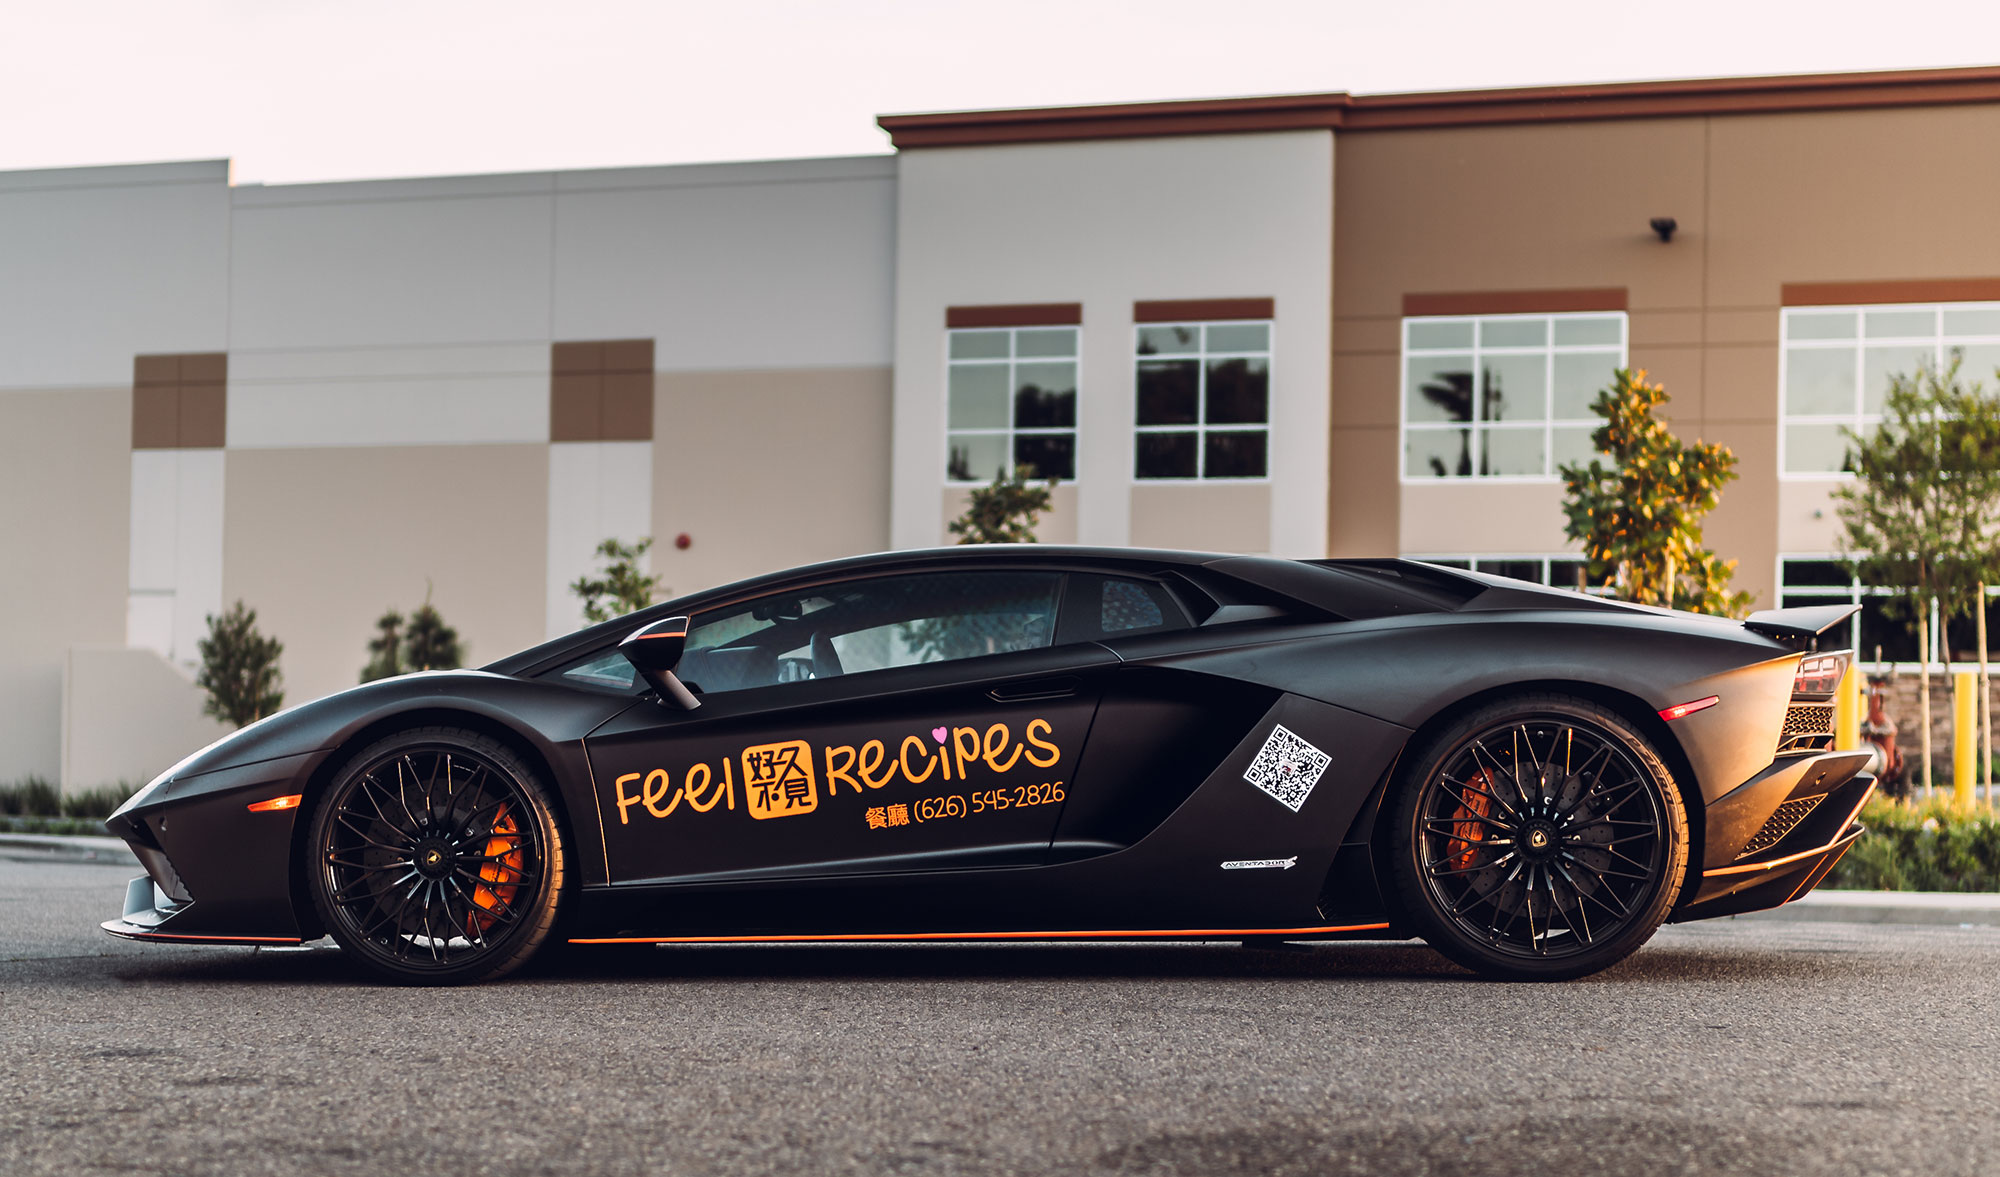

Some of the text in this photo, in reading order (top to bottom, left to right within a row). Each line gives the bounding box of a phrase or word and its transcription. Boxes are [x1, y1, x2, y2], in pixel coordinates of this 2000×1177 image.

[616, 719, 1061, 824] Feel Recipes
[865, 782, 1066, 829] 餐廳 (626) 545-2826
